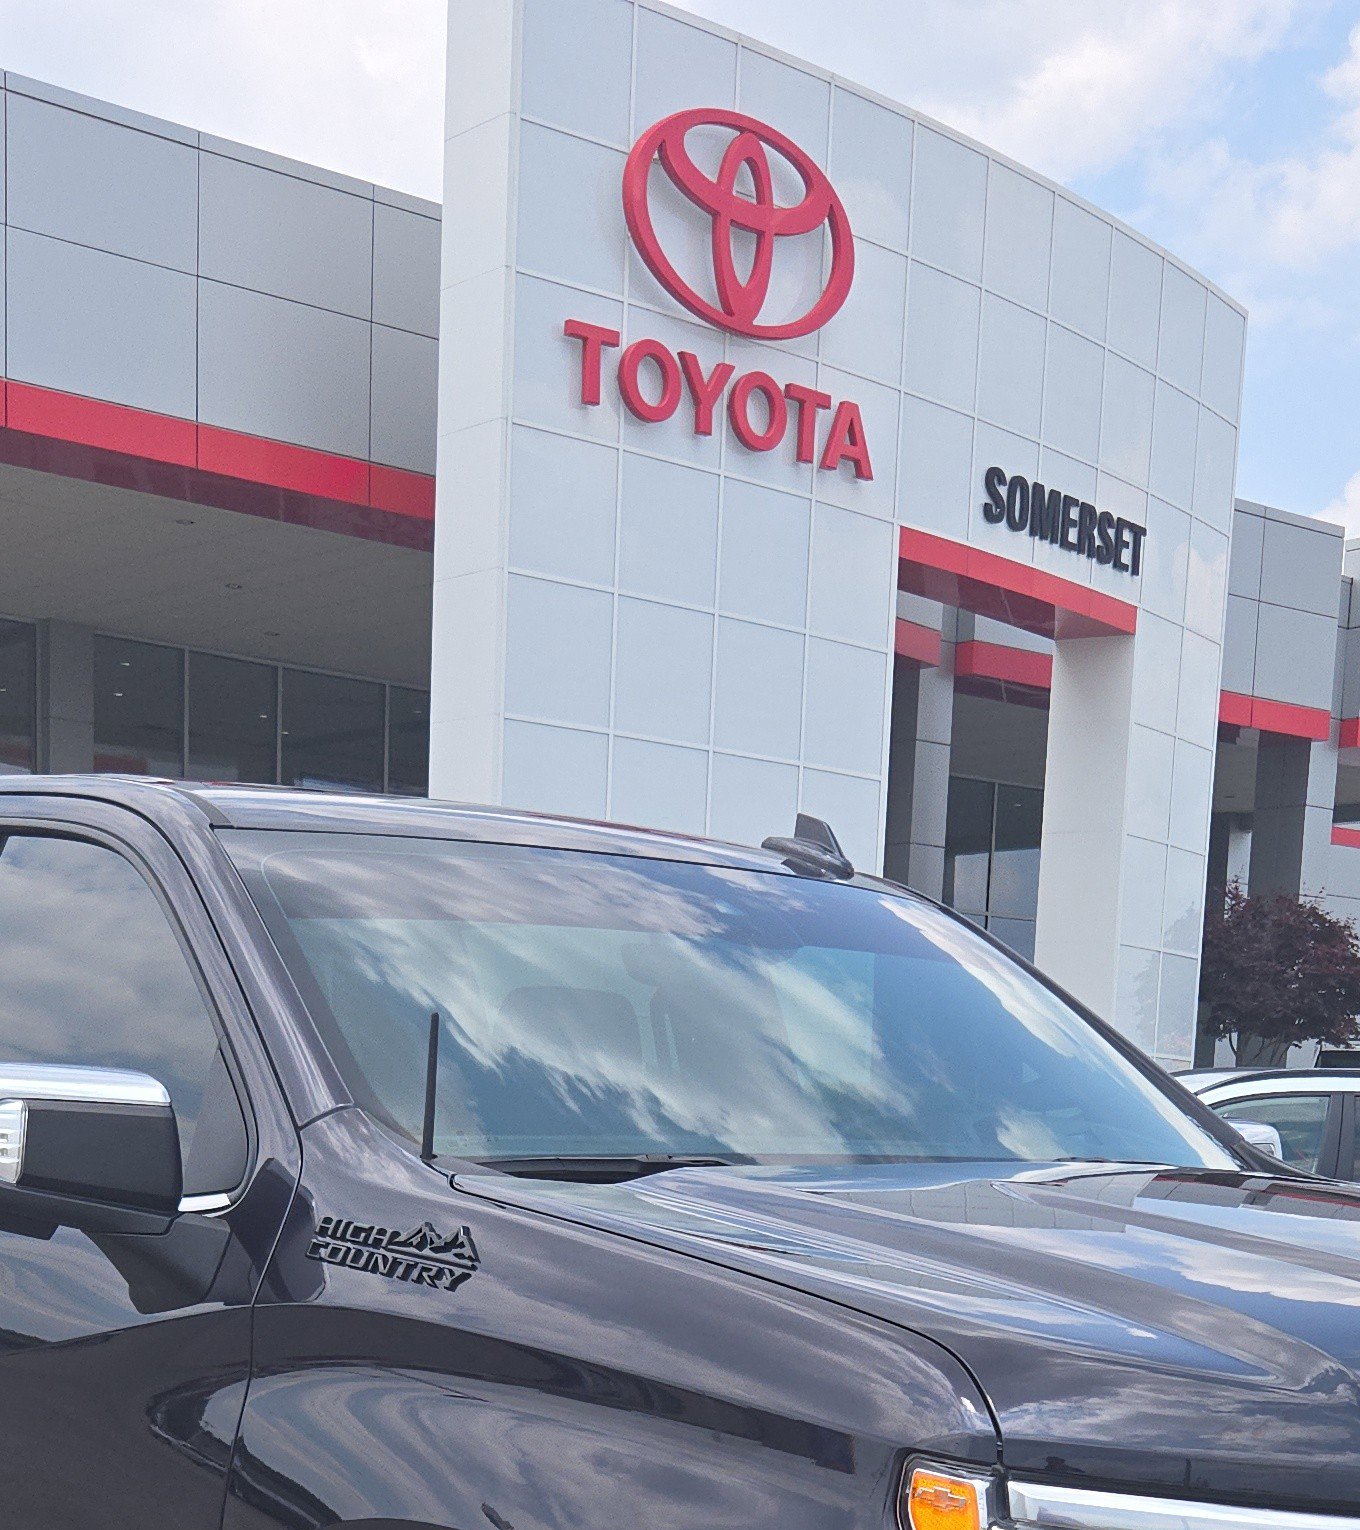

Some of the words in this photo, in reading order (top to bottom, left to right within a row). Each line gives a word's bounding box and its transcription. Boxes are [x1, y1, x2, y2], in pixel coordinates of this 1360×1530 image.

[564, 319, 874, 482] TOYOTA
[983, 466, 1147, 577] SOMERSET
[305, 1239, 472, 1292] COUNTRY
[314, 1216, 401, 1249] HIGH
